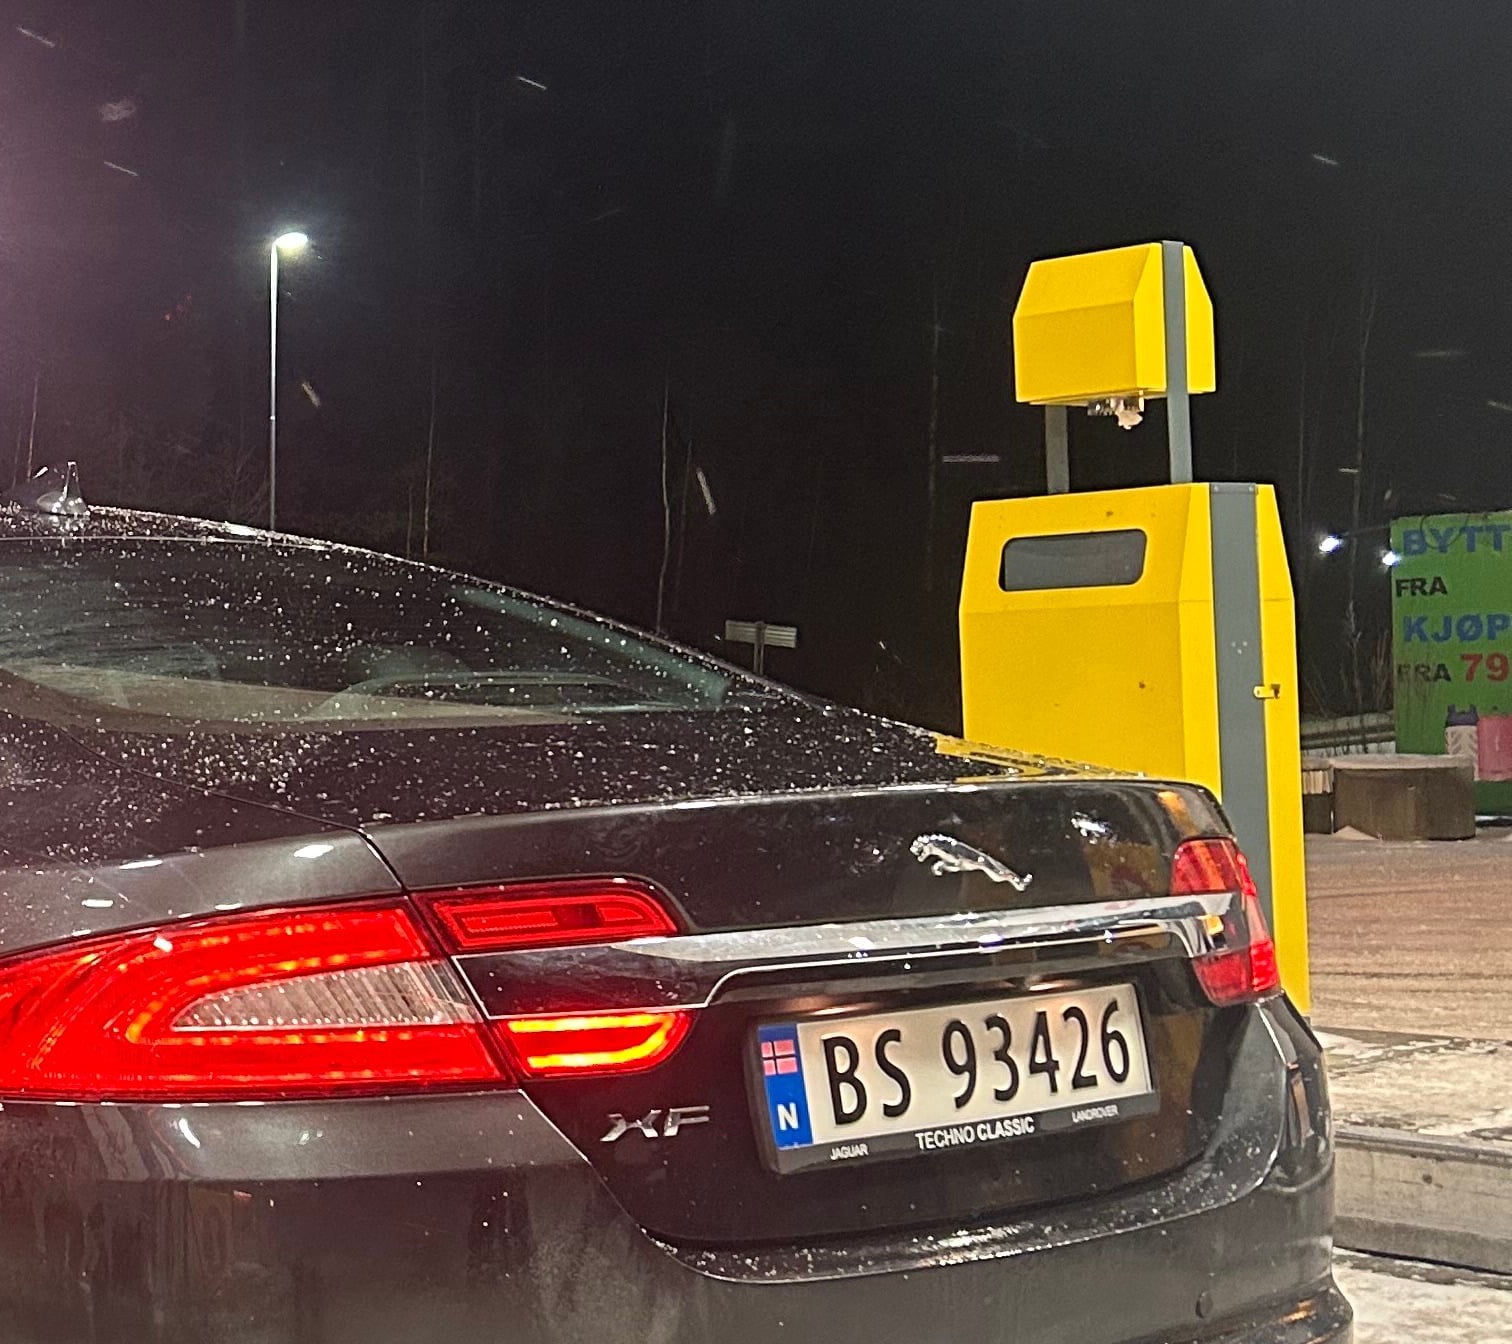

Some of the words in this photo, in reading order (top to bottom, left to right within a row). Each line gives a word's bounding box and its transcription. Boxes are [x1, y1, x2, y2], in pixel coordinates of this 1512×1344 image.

[1396, 576, 1448, 597] FRA
[1403, 613, 1511, 643] KJØP
[1397, 663, 1451, 683] FRA
[822, 1029, 911, 1125] BS
[942, 998, 1129, 1109] 93426
[600, 1105, 710, 1142] XF
[777, 1102, 799, 1130] N
[915, 1124, 975, 1150] TECHNO
[977, 1116, 1035, 1141] CLASSIC
[830, 1143, 869, 1160] JAGUAR
